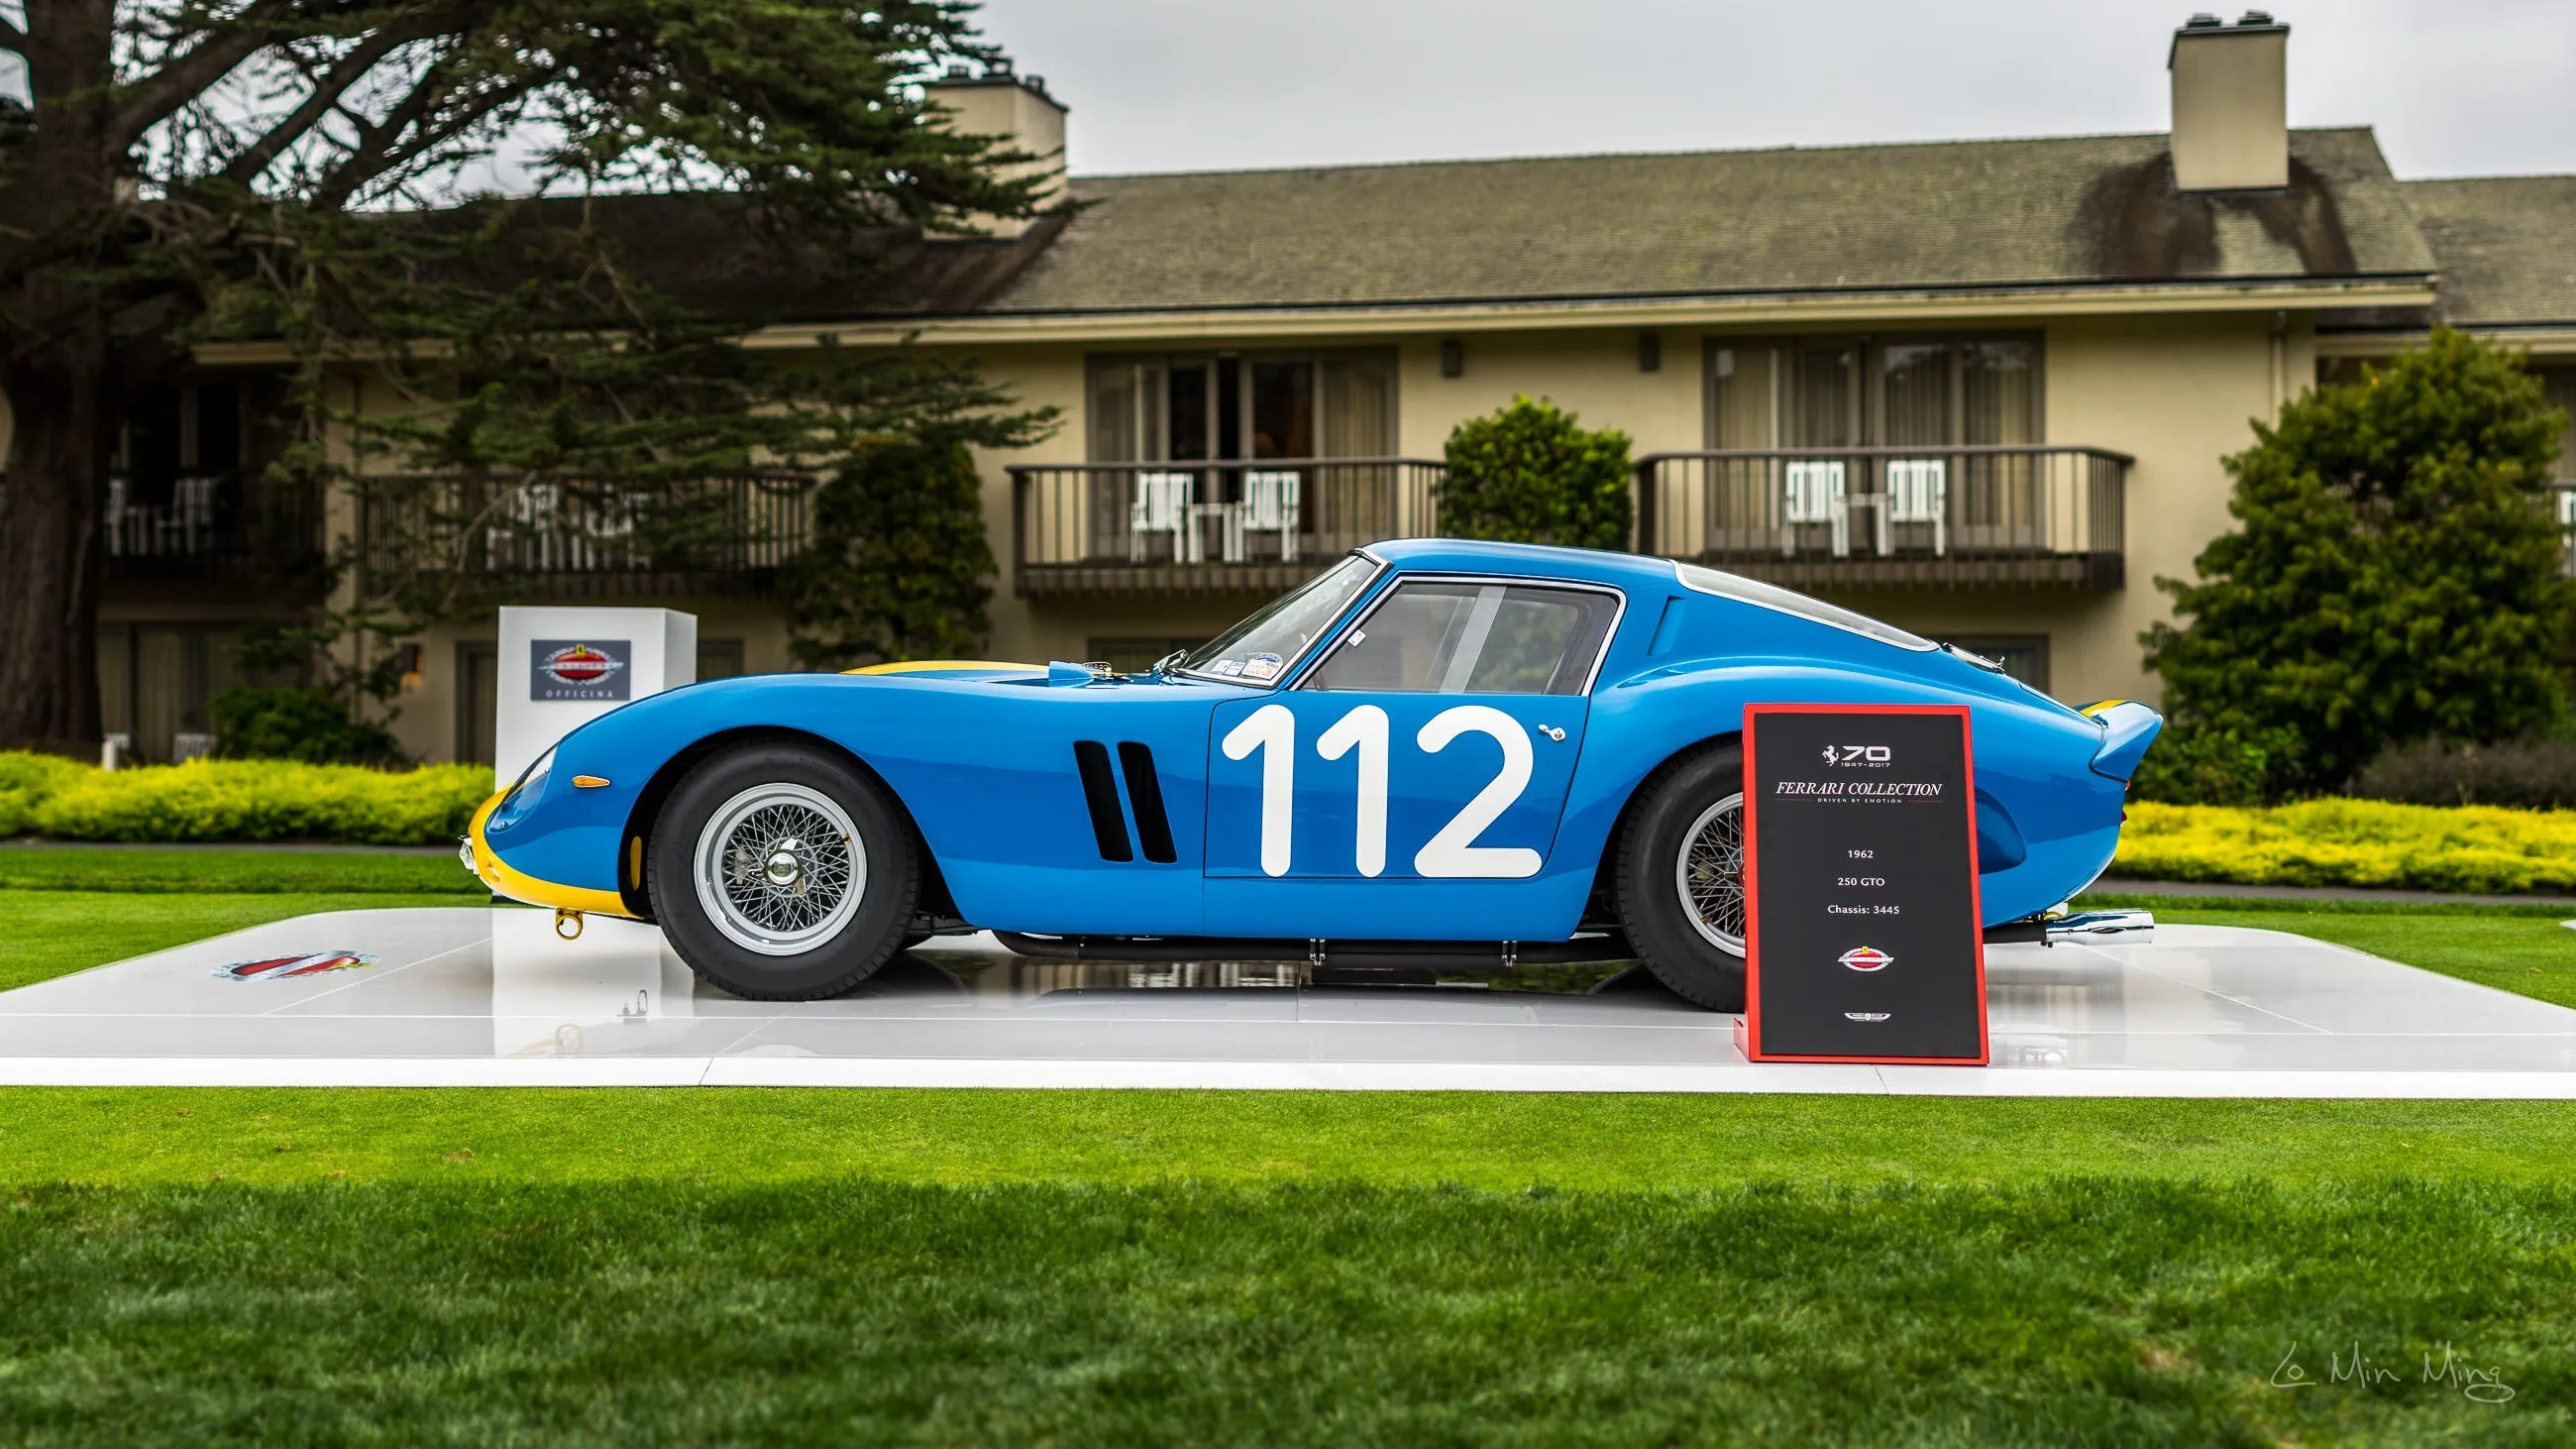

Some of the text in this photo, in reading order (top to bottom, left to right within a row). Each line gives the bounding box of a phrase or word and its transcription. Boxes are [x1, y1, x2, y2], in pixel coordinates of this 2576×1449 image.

[546, 689, 613, 699] OFFICINA
[1841, 745, 1891, 761] 70
[1222, 704, 1543, 878] 112
[1775, 781, 1943, 796] FERRARI COLLECTION
[1847, 849, 1874, 859] 1962
[1837, 877, 1885, 887] 250 GTO
[1827, 904, 1900, 915] Chassis: 3445
